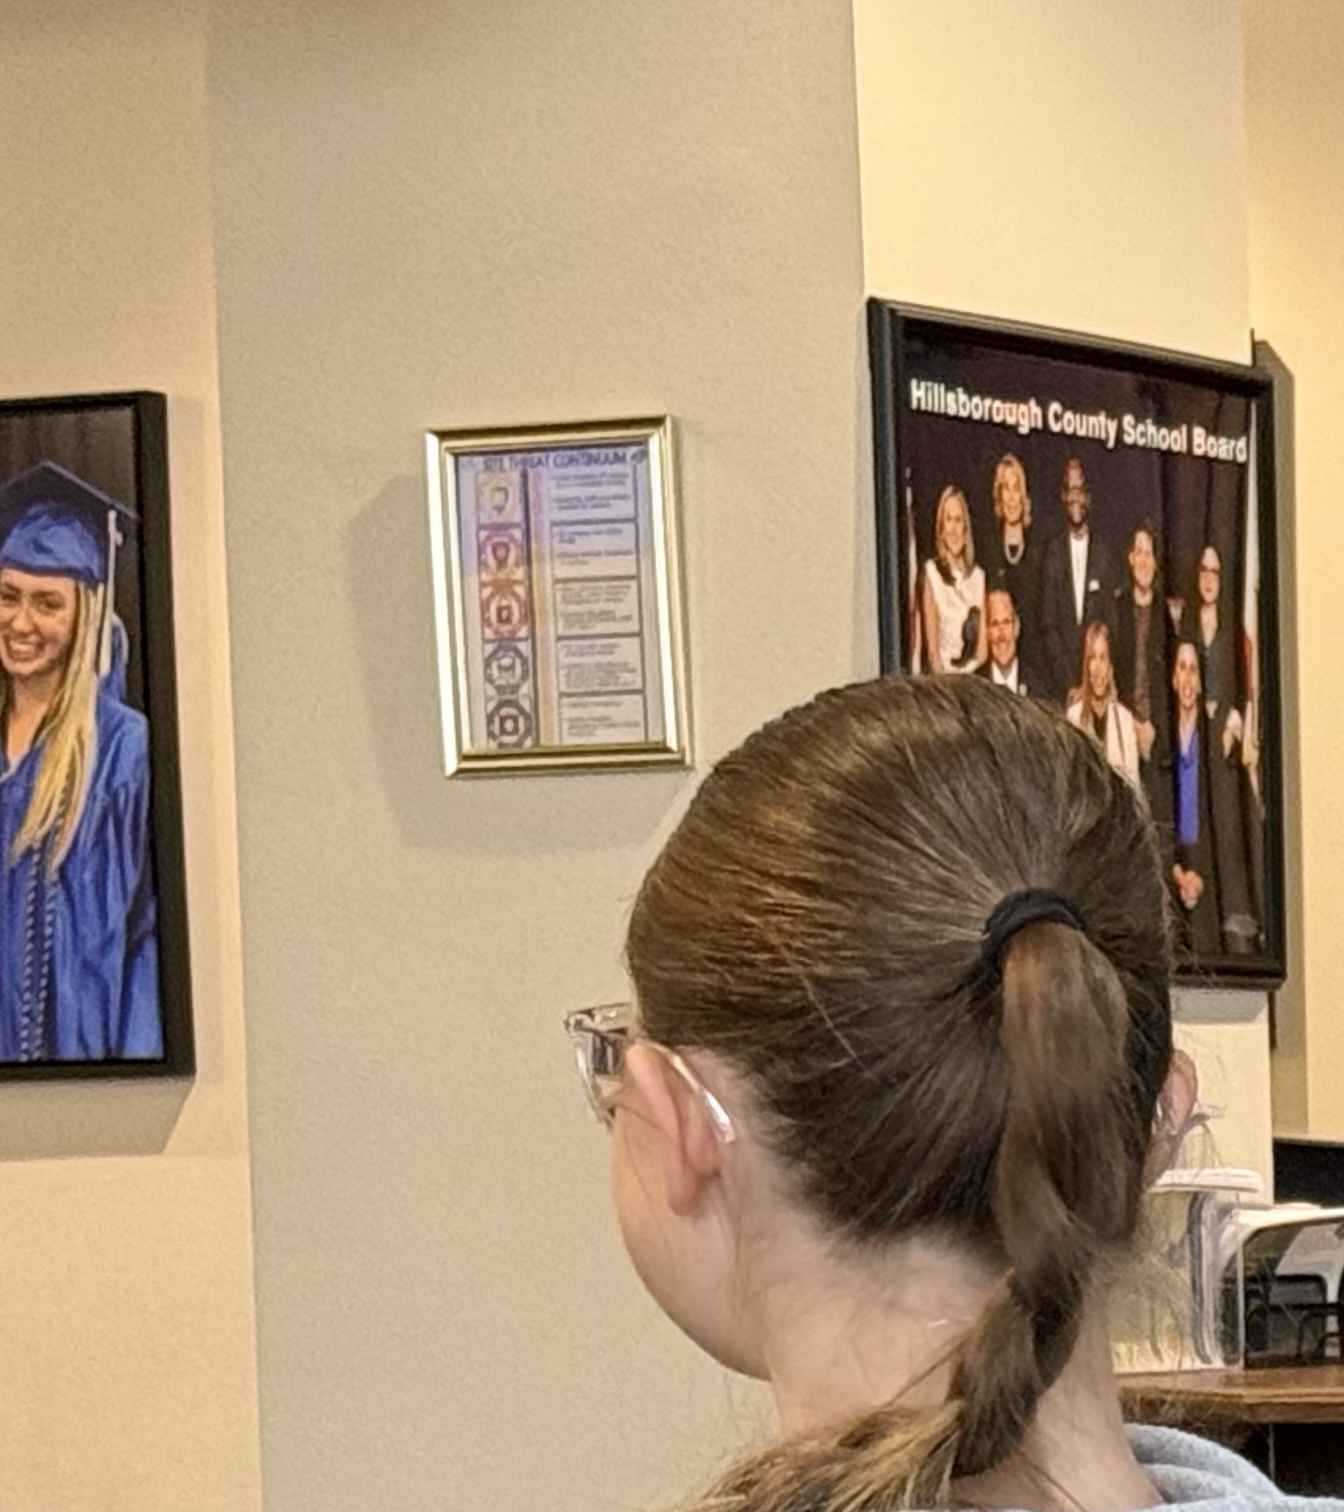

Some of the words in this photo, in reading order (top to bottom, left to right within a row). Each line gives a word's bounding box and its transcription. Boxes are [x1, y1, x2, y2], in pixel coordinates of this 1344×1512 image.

[910, 378, 1043, 434] Hillsborough
[1049, 401, 1118, 449] County
[1122, 414, 1188, 453] School
[1192, 426, 1248, 463] Board
[553, 451, 627, 468] CONTINUUM
